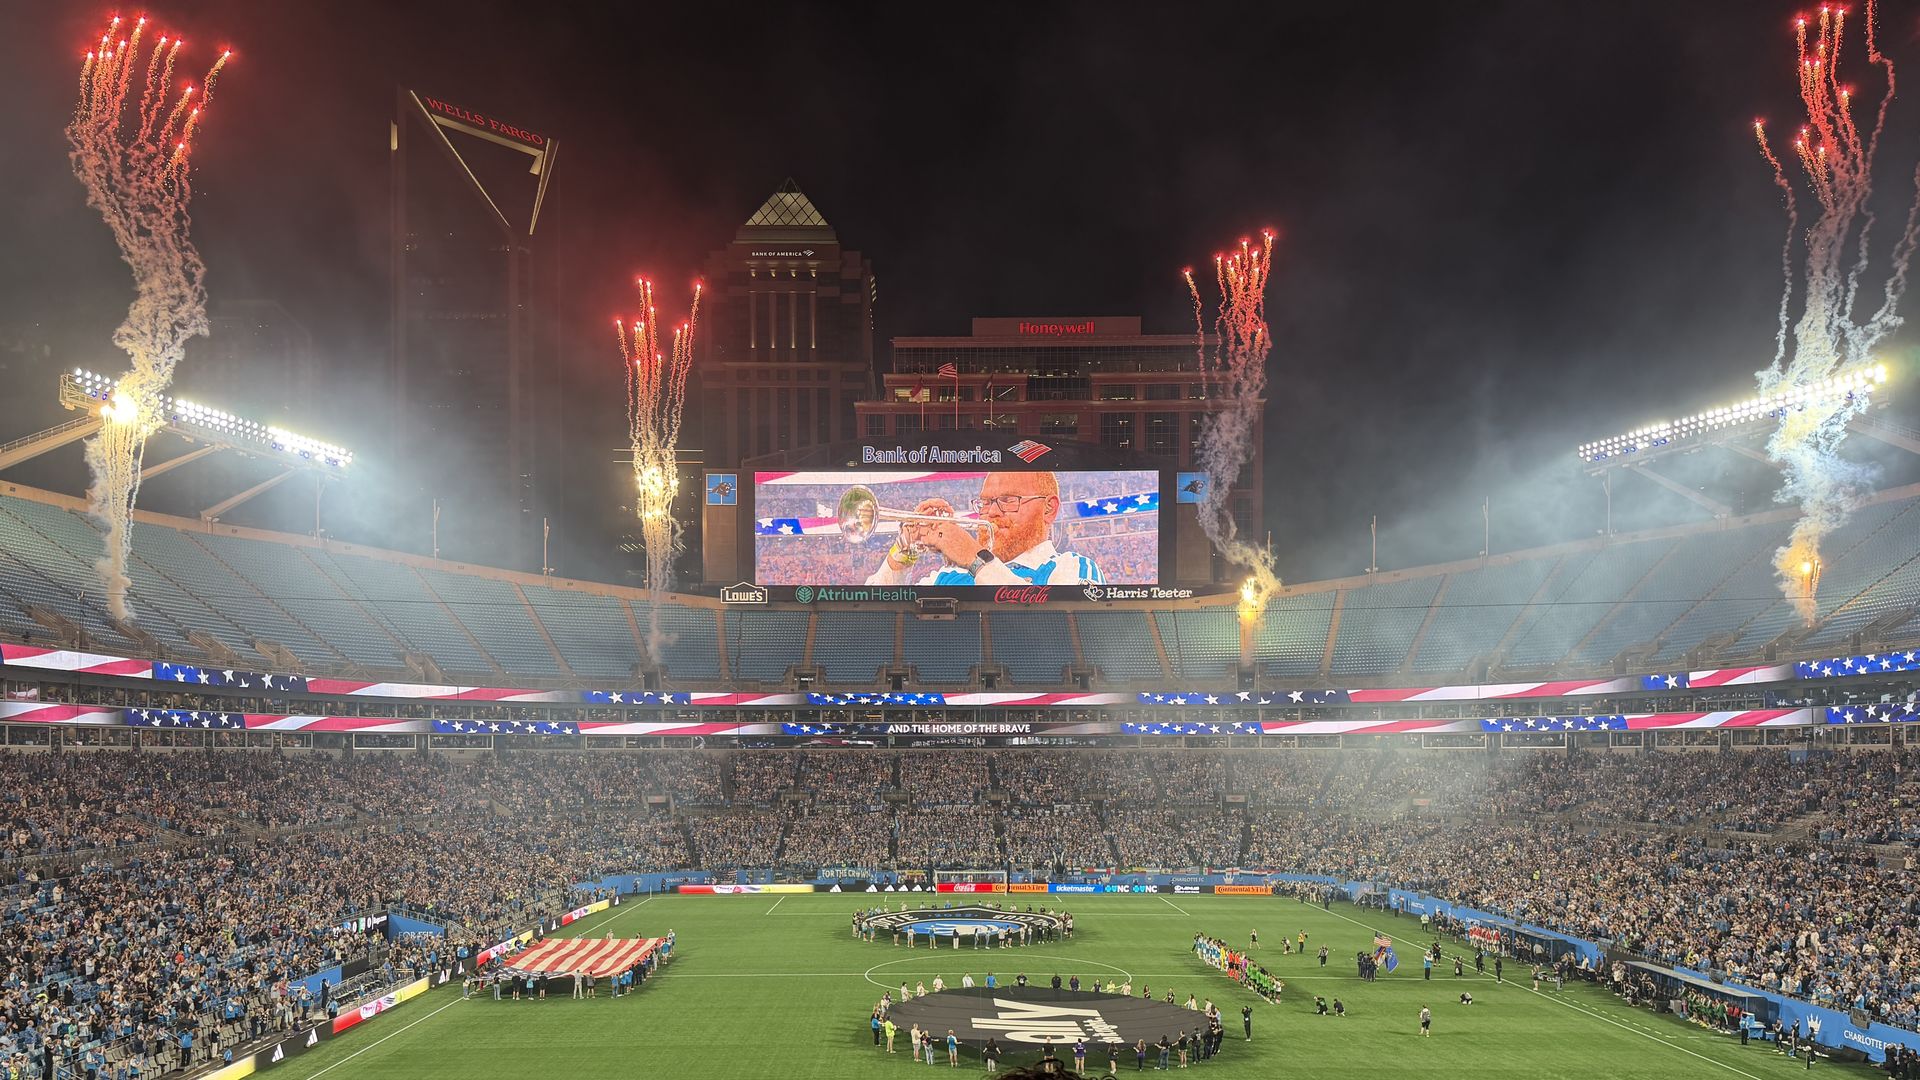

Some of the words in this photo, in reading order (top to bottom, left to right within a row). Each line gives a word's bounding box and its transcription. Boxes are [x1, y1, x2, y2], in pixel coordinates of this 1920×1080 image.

[425, 96, 485, 126] WELLS
[489, 118, 543, 145] FARGO
[1019, 321, 1095, 337] Honeywell
[862, 445, 908, 463] Bank
[908, 445, 928, 463] of
[929, 445, 1002, 463] America
[817, 588, 869, 601] Atrium
[870, 588, 917, 601] Health
[1106, 587, 1148, 599] Harris
[1151, 587, 1192, 599] Teeter
[888, 724, 910, 733] AND
[912, 724, 930, 733] THE
[932, 724, 962, 733] HOME
[964, 724, 978, 733] OF
[979, 724, 998, 733] THE
[1000, 724, 1031, 733] BRAVE
[822, 869, 835, 877] FOR
[836, 869, 848, 877] THE
[971, 998, 1101, 1044] ally
[1843, 1030, 1883, 1050] CHARLOTTE
